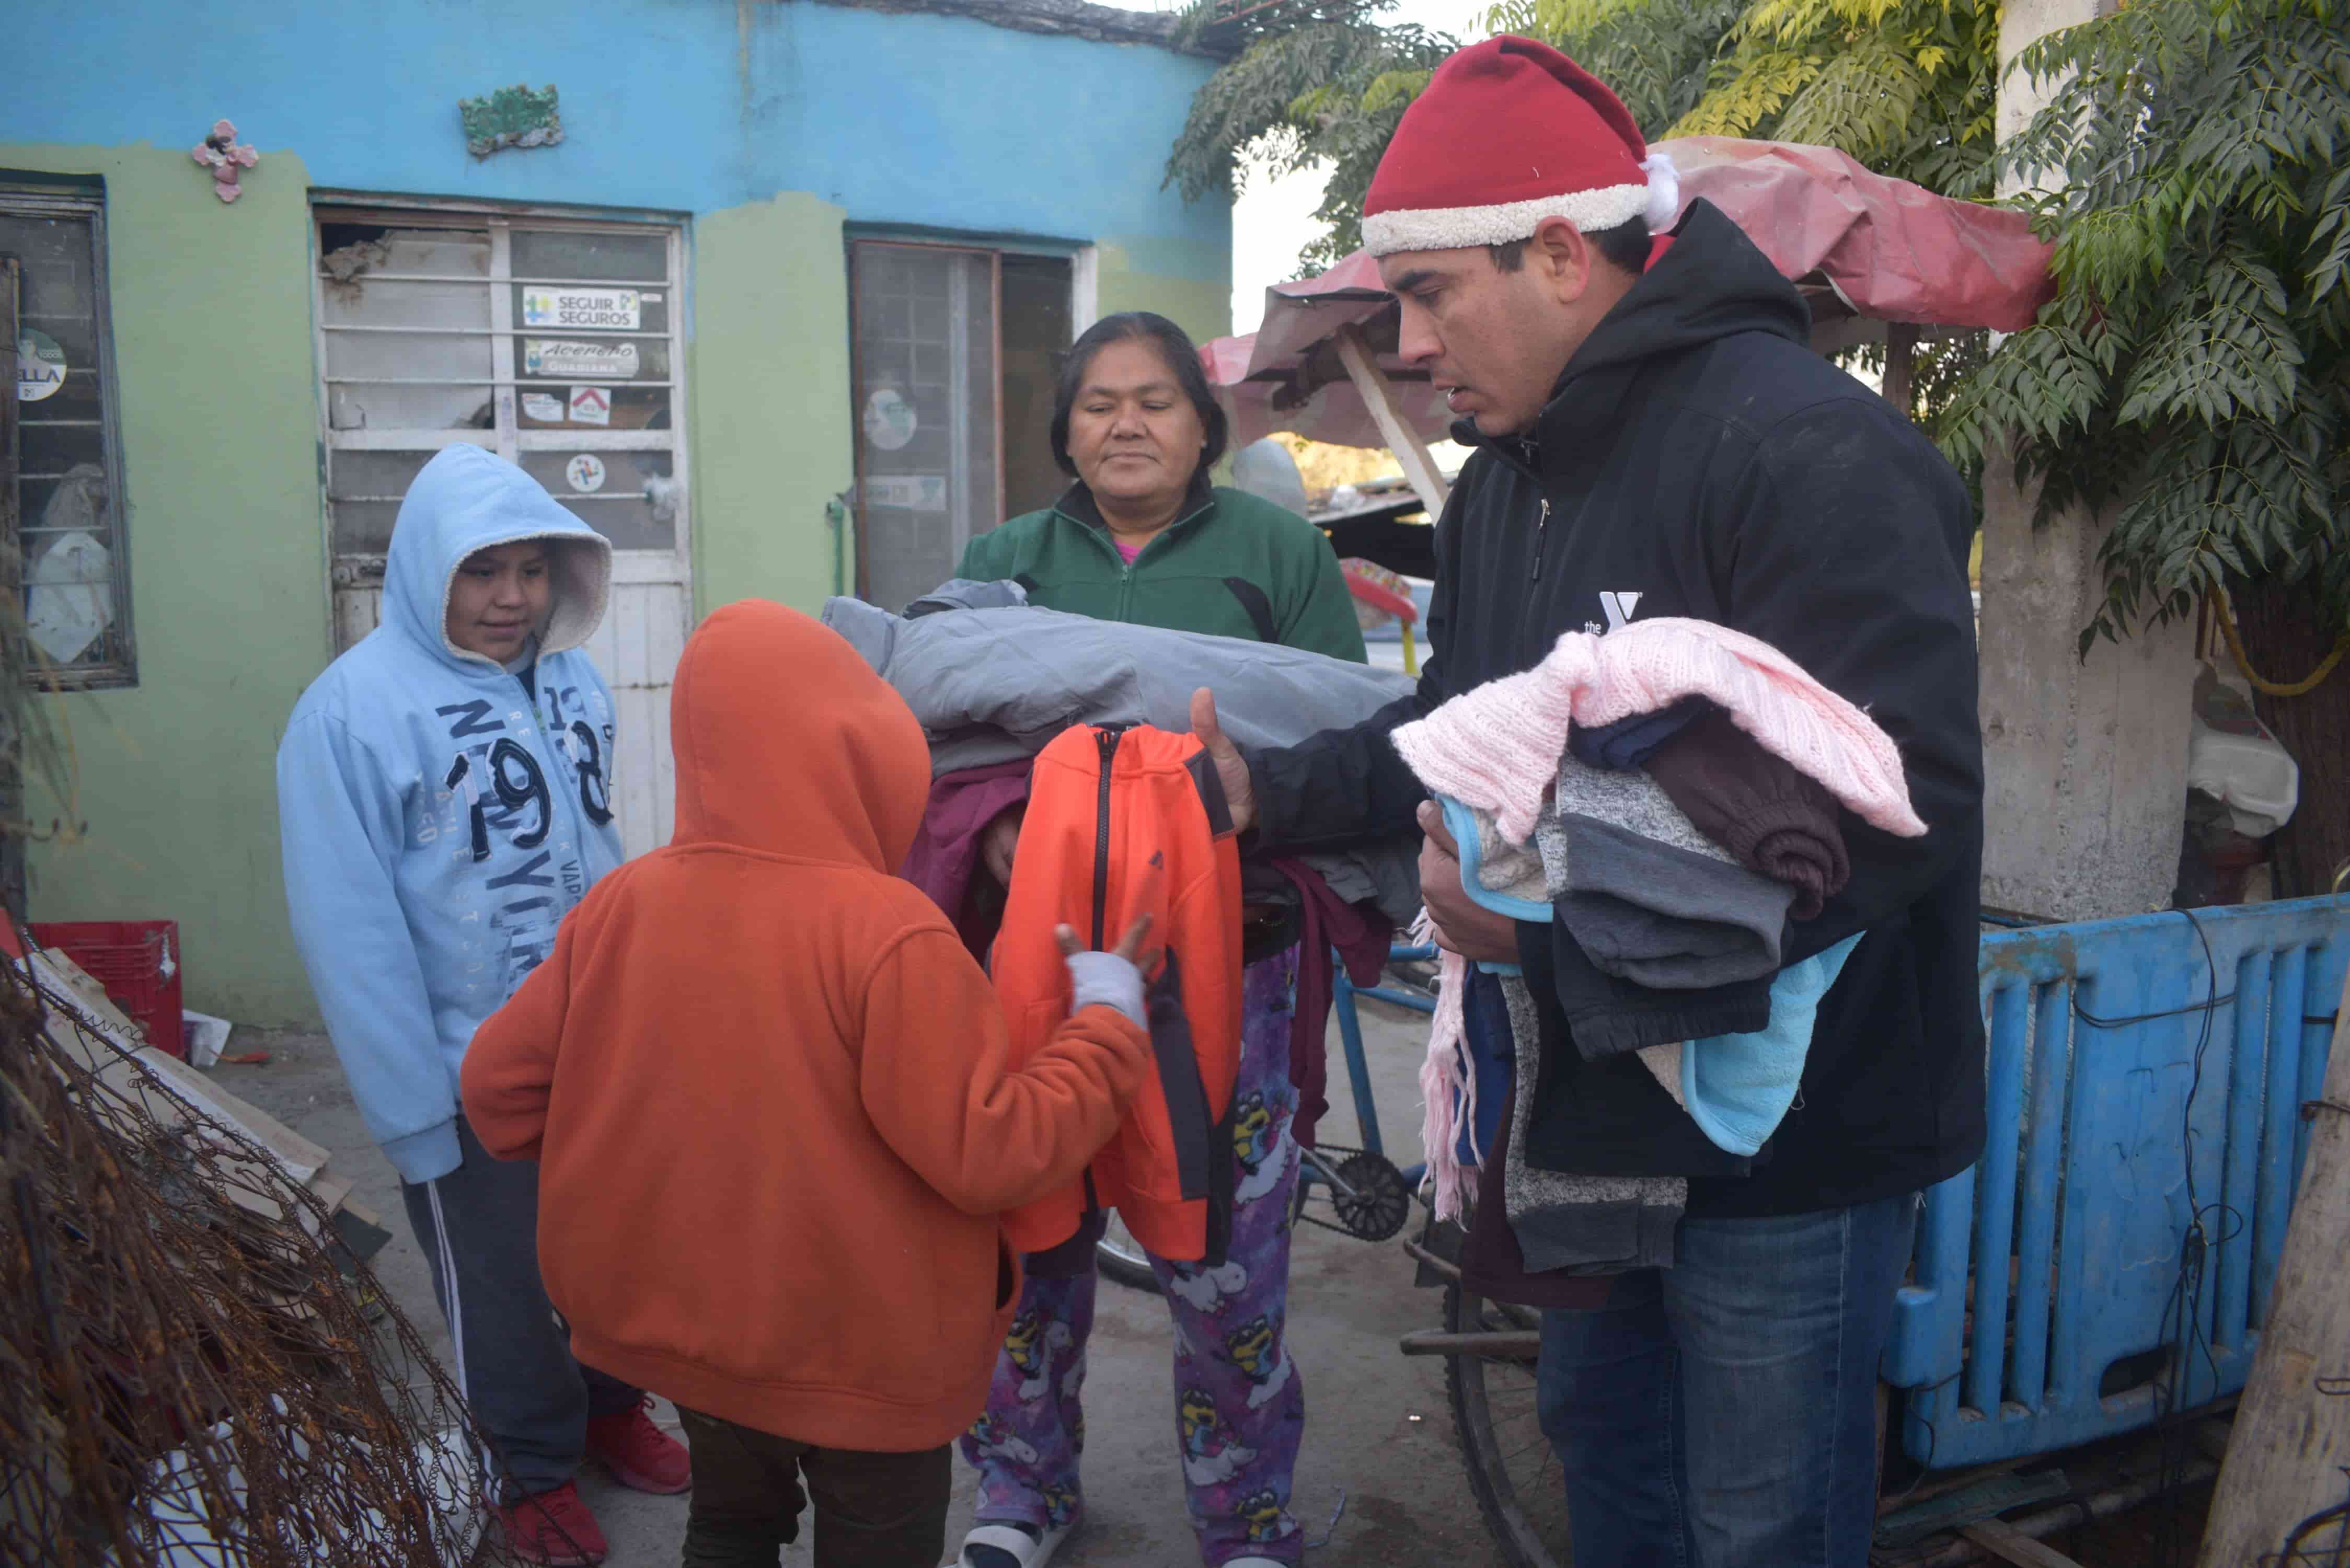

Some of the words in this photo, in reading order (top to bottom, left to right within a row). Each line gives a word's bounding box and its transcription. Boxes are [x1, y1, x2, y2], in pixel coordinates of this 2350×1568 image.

[558, 296, 614, 310] SEGUIR
[558, 312, 630, 325] SEGUROS
[1584, 620, 1602, 634] the
